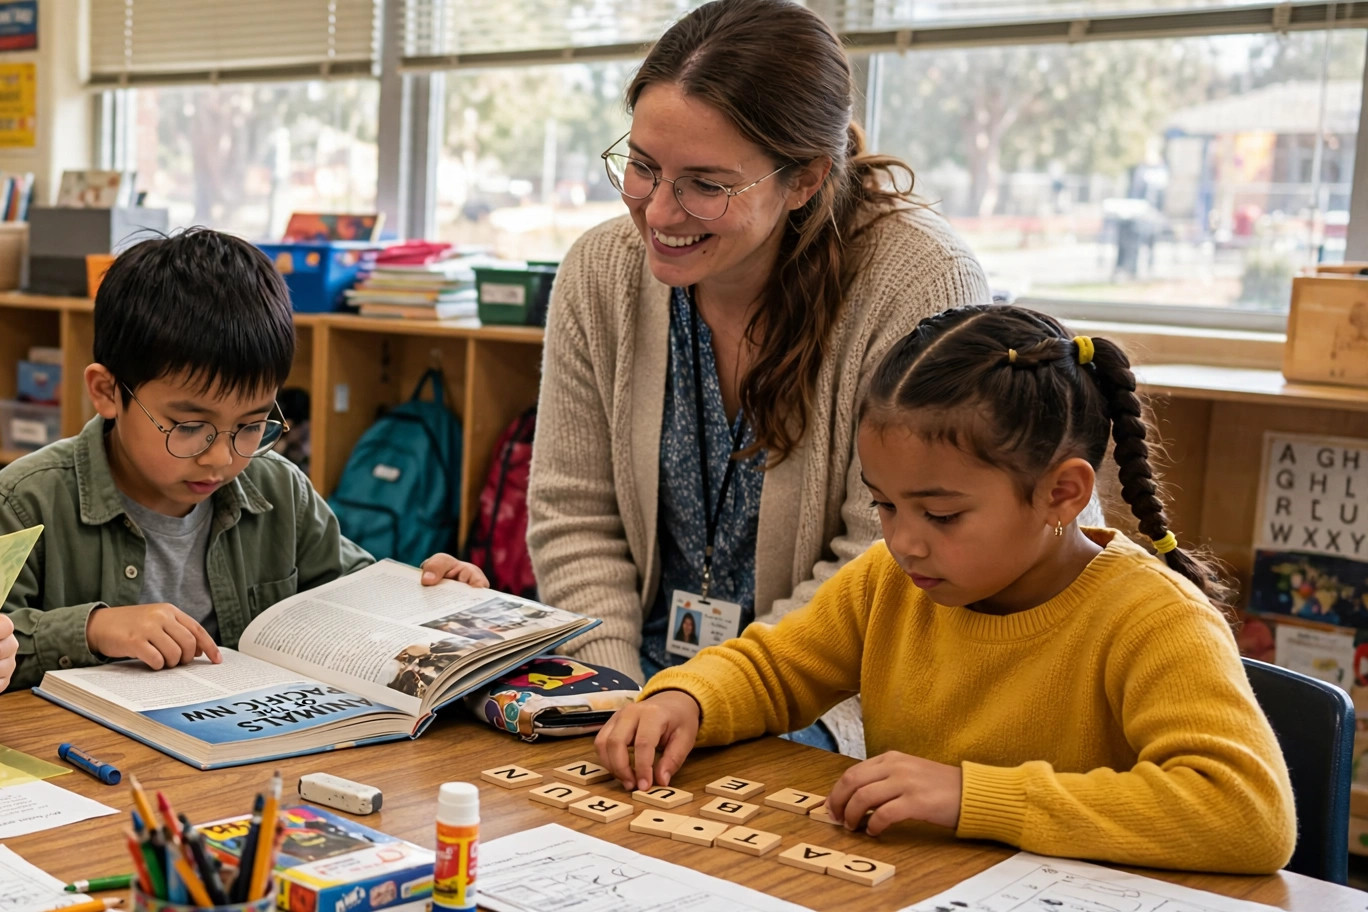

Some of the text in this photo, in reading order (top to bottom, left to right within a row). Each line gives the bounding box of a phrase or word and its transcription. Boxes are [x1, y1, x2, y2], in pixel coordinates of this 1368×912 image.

[1278, 444, 1360, 470] A G H
[1276, 468, 1356, 498] G H L
[1275, 496, 1292, 516] R
[1340, 503, 1358, 524] U
[1270, 522, 1366, 554] W X X Y
[182, 686, 346, 722] PACIFIC NW
[237, 697, 375, 732] ANIMALS
[252, 699, 317, 717] OF THE
[494, 768, 619, 812] R U N
